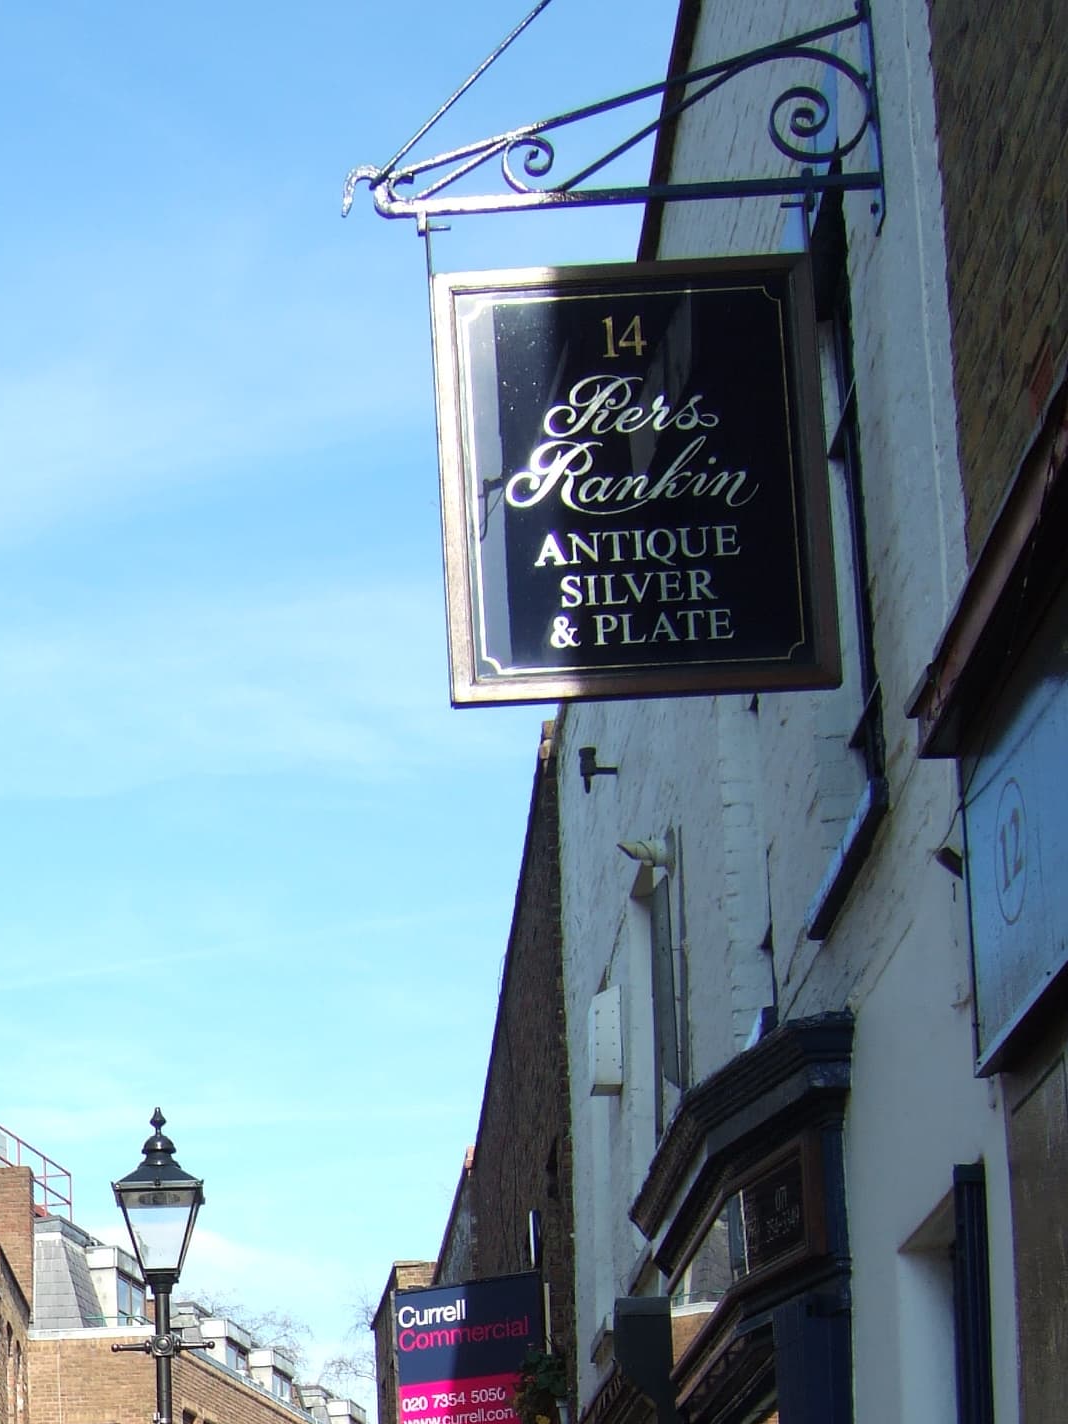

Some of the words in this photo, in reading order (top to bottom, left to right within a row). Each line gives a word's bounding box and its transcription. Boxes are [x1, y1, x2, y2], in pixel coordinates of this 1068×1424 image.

[601, 314, 647, 358] 14
[543, 374, 719, 437] Piers
[505, 435, 759, 515] Rankin
[534, 525, 741, 568] ANTIQUE
[560, 570, 718, 608] SILVER
[550, 616, 580, 649] &
[593, 609, 735, 646] PLATE
[999, 807, 1023, 894] 12
[398, 1299, 467, 1328] Currell
[398, 1316, 530, 1352] Commercial
[402, 1396, 428, 1412] 020
[431, 1392, 465, 1408] 7354
